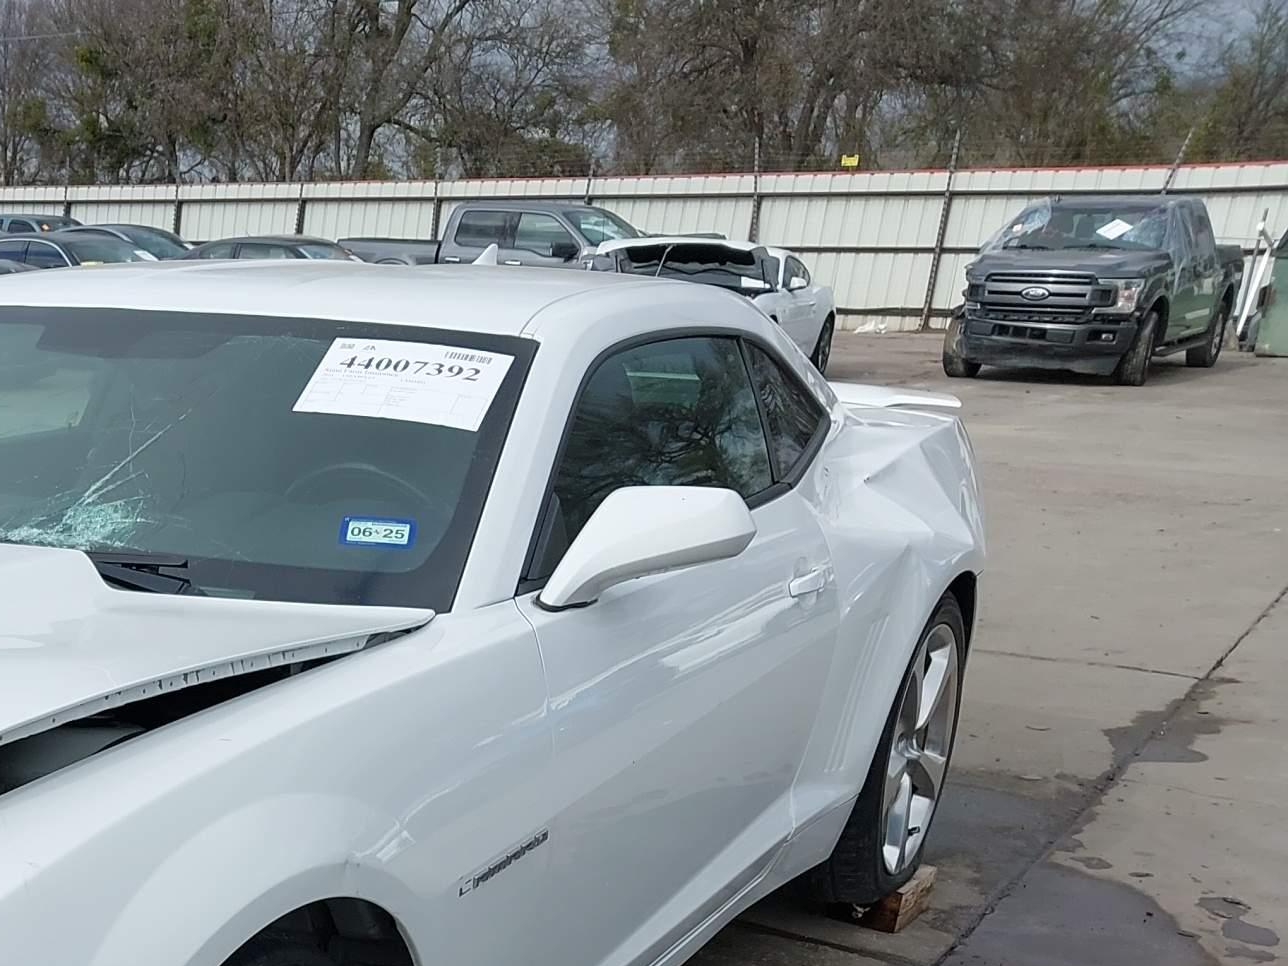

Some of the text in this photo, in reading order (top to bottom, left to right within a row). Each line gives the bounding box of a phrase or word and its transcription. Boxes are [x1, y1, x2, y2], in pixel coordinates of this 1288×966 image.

[339, 355, 481, 382] 44007392
[350, 526, 406, 540] 06 25
